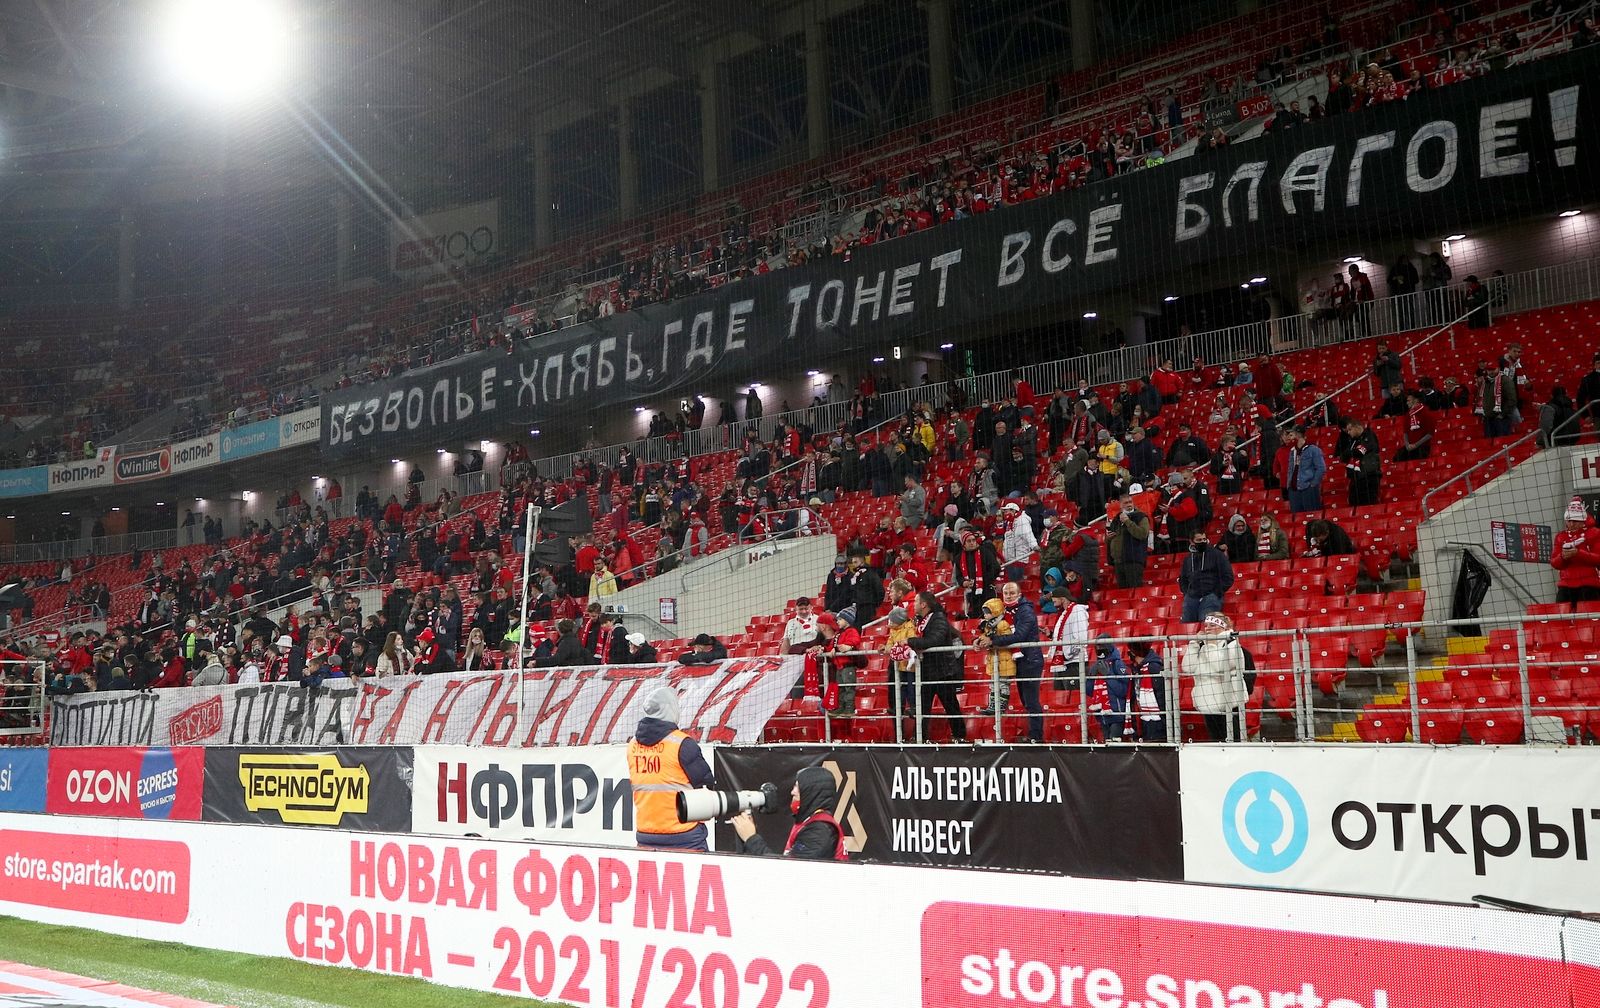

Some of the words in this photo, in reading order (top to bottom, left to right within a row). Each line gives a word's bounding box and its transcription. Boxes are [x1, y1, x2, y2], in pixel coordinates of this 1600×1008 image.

[1251, 100, 1269, 114] 207
[787, 248, 962, 339] ТОНЕТ
[998, 192, 1123, 287] ВСЁ
[1174, 85, 1580, 244] БЛАГОЕ!
[121, 459, 158, 475] Winline
[633, 755, 660, 774] T260
[66, 769, 131, 803] OZON
[137, 767, 178, 798] EXPRESS
[437, 762, 633, 829] НФПРи
[891, 766, 1062, 803] АЛЬТЕРНАТИВА
[891, 818, 974, 855] ИНВЕСТ
[4, 851, 176, 895] store.spartak.com
[350, 840, 498, 911] НОВАЯ
[513, 849, 732, 938] ФОРМА
[285, 901, 433, 978] СЕЗОНА
[493, 926, 830, 1008] 2021/2022
